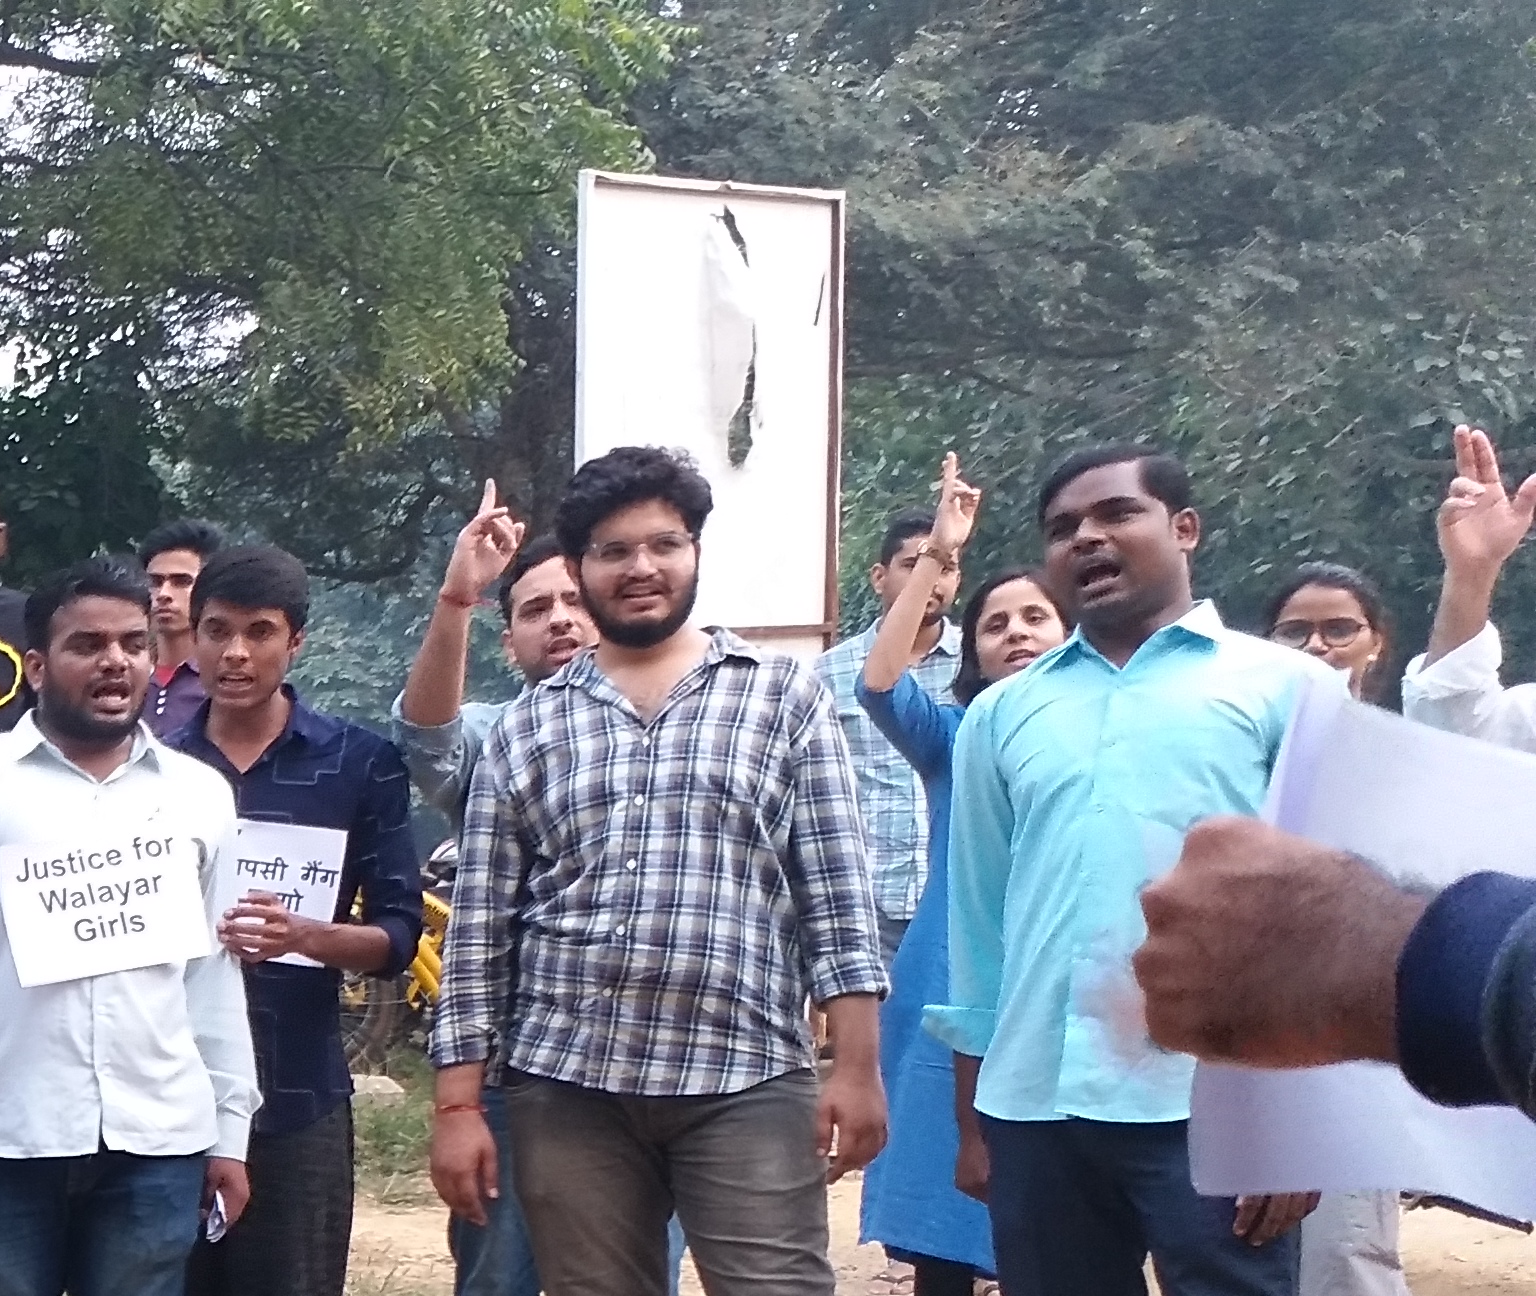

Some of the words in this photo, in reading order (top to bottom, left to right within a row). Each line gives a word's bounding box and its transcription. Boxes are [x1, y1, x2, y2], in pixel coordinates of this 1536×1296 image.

[16, 848, 123, 883] Justice
[132, 836, 174, 861] for
[38, 874, 163, 914] Walayar
[73, 911, 146, 942] Girls
